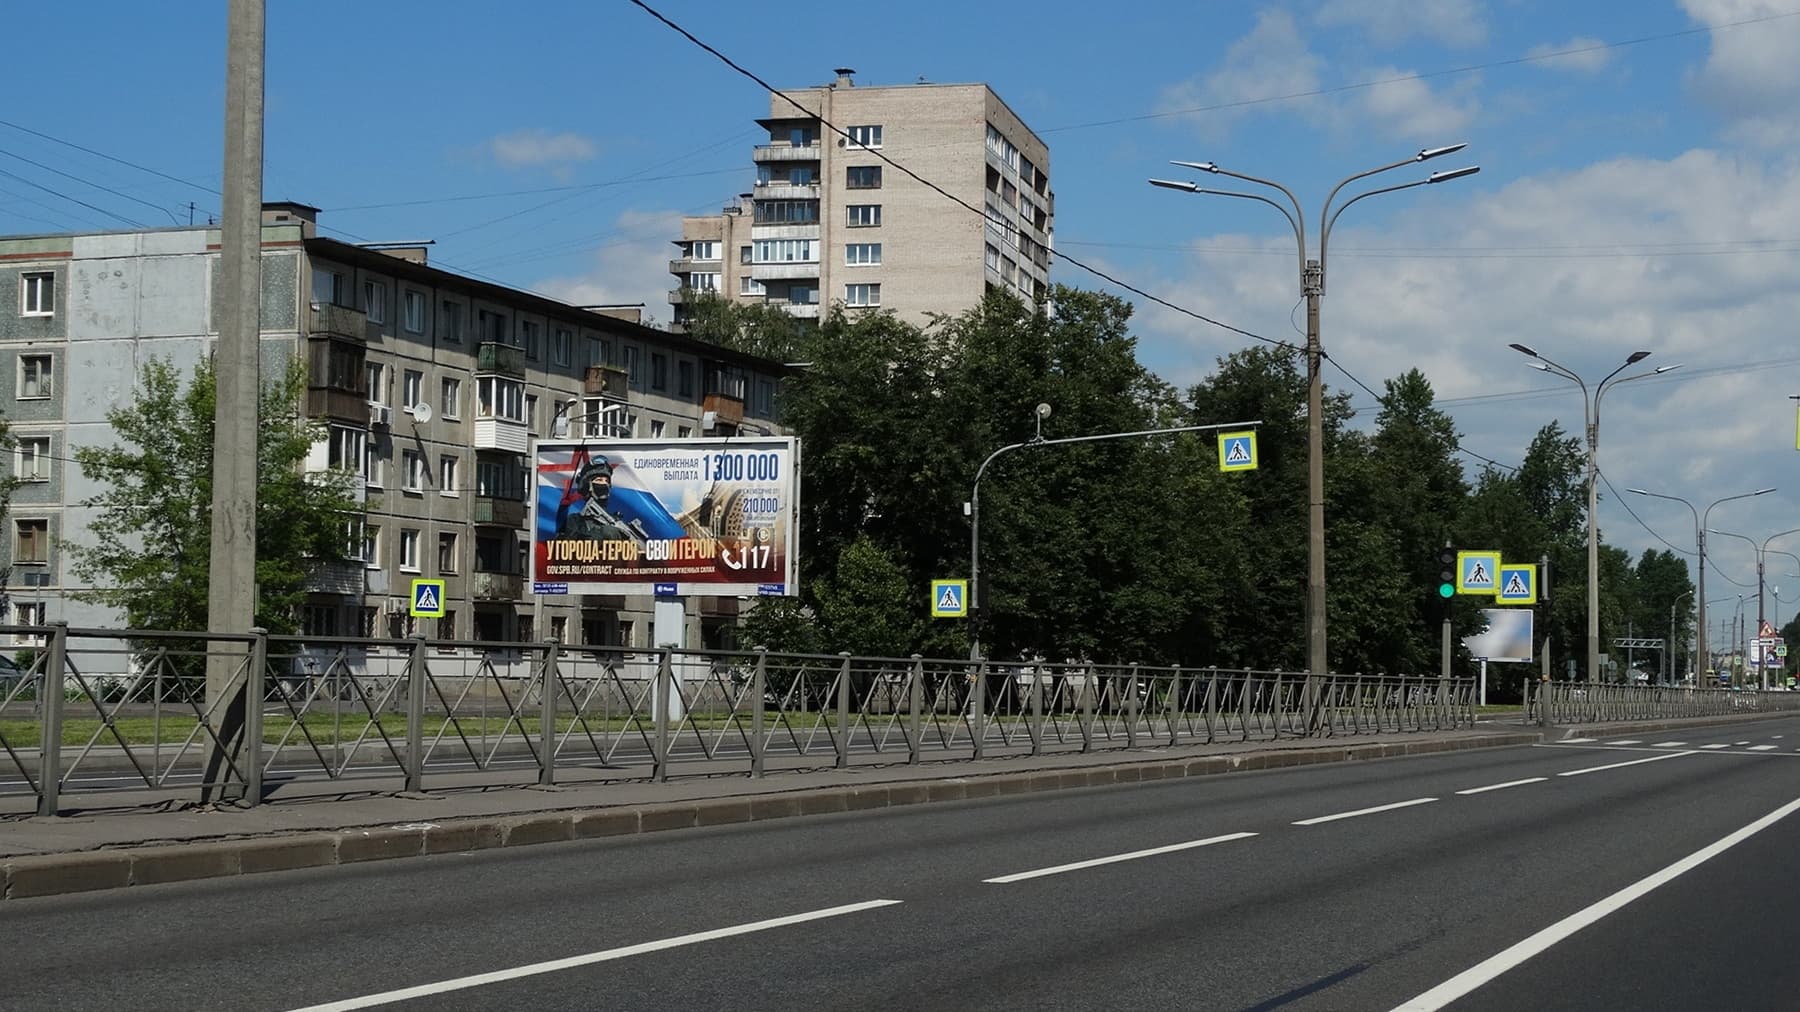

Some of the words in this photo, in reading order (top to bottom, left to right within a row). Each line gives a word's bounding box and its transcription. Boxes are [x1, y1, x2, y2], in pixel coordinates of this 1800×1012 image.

[634, 458, 699, 469] ЕДИНОВРЕМЕННАЯ
[664, 470, 698, 480] ВЫПЛАТА
[547, 540, 554, 560] У
[555, 540, 637, 563] ГОРОДА-ГЕРОЯ
[646, 539, 677, 560] СВОИ
[679, 538, 715, 560] ГЕРОИ
[740, 545, 770, 569] 117
[546, 565, 612, 575] GOV.SPB.RU/CONTRACT
[614, 567, 632, 575] СЛУЖБА
